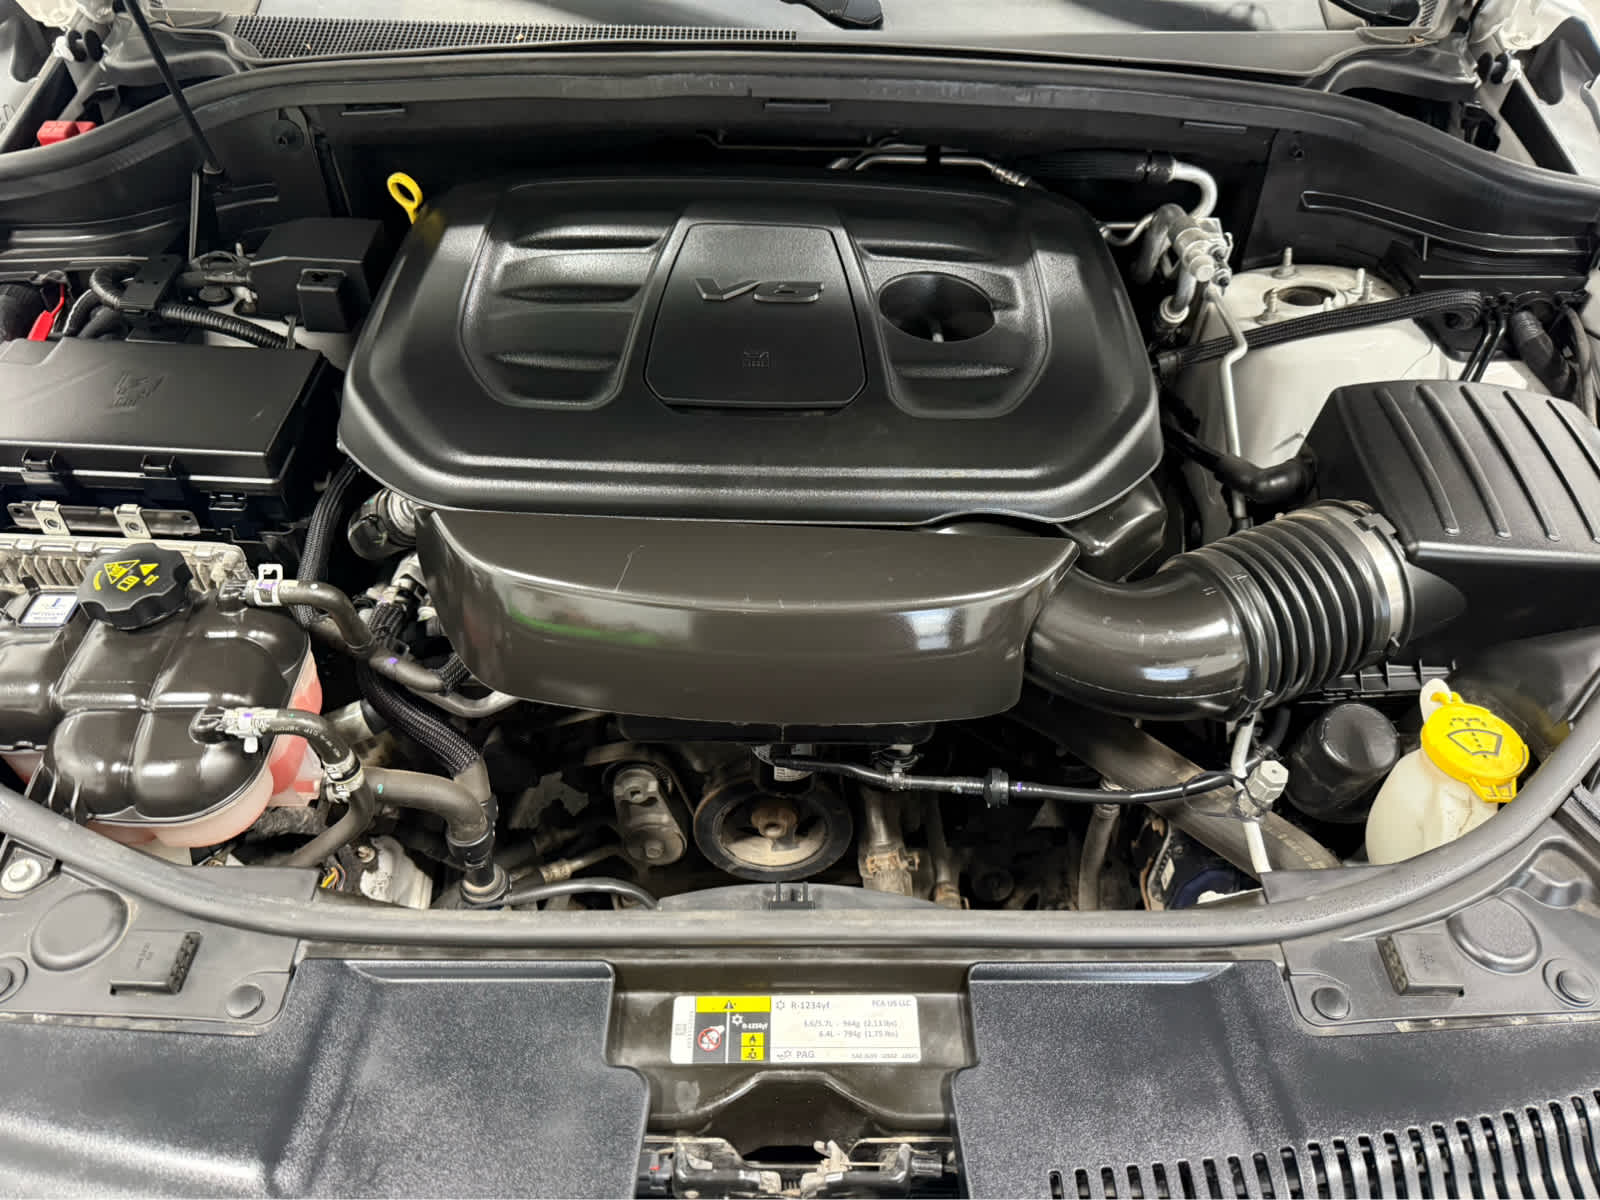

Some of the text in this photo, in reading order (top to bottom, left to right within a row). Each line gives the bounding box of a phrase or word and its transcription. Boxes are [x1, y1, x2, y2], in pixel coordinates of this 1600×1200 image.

[694, 278, 825, 304] V6
[791, 1000, 831, 1012] R-1234yf
[796, 1050, 815, 1059] PAG
